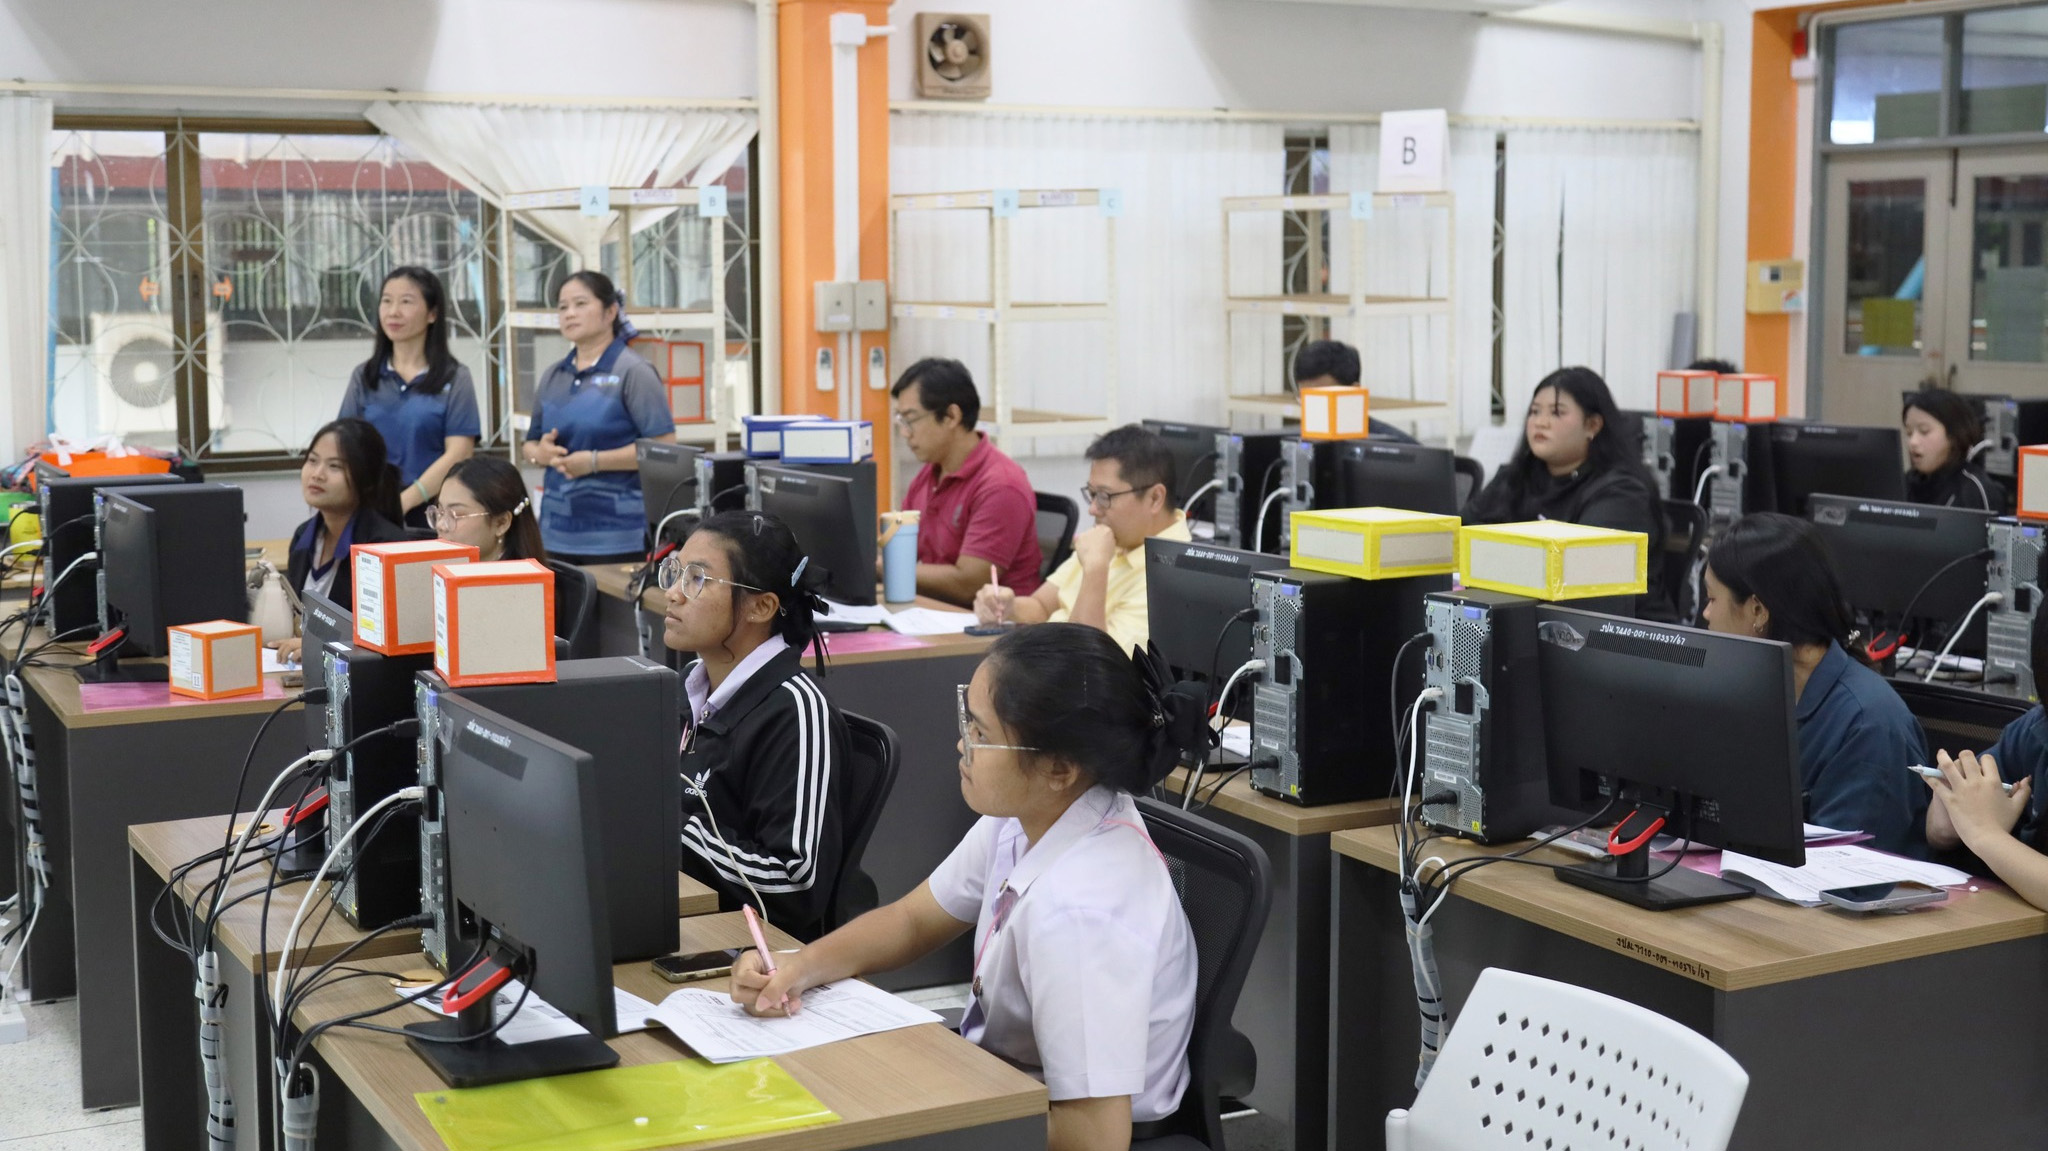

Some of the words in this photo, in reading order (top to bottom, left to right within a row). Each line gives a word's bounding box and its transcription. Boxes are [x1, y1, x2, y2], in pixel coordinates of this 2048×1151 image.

[1402, 136, 1416, 165] B
[590, 196, 599, 206] A
[709, 197, 717, 207] B
